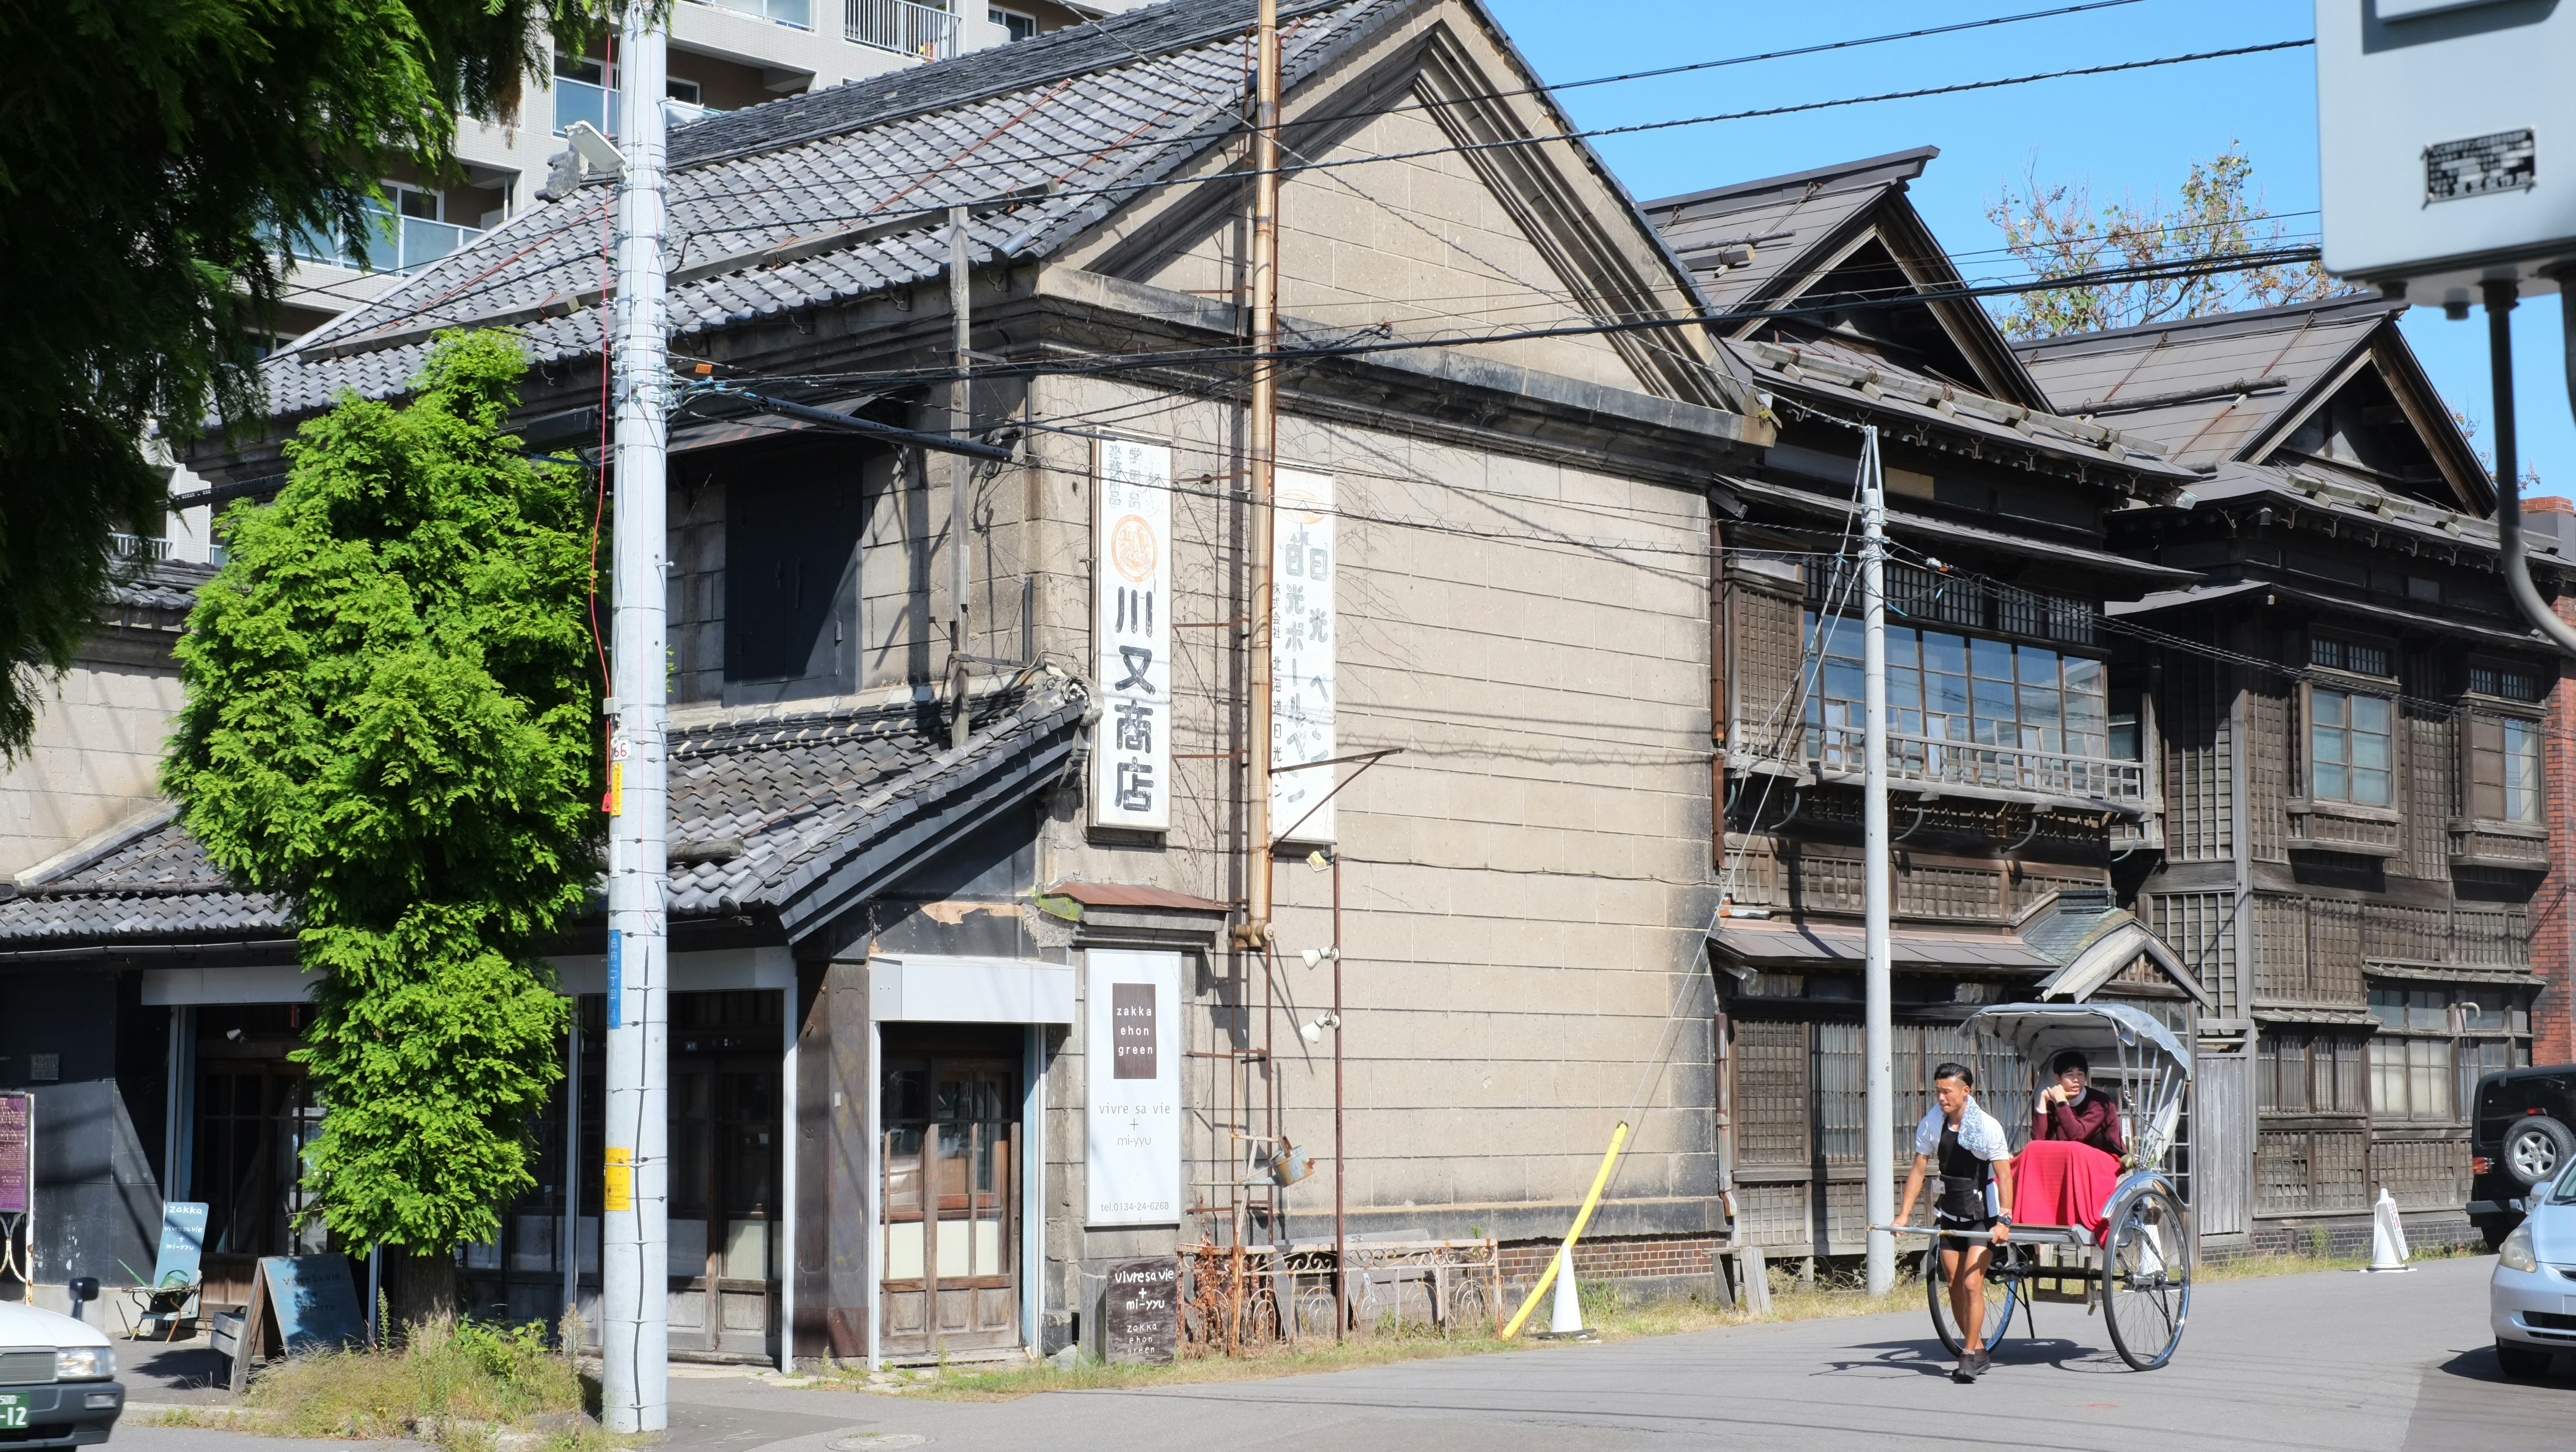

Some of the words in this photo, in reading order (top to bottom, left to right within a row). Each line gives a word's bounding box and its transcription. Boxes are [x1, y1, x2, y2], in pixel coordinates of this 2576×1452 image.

[1114, 586, 1156, 812] 川又商店
[1116, 1005, 1152, 1016] zakka
[1120, 1025, 1149, 1036] ehon
[1118, 1046, 1153, 1056] green
[1099, 1102, 1129, 1114] vivre
[1135, 1105, 1147, 1114] sa
[1153, 1102, 1170, 1114] vie
[1117, 1134, 1151, 1148] mi-yyu
[169, 1205, 202, 1215] zakka
[1101, 1202, 1169, 1212] tel.0134-24-6268
[1115, 1270, 1144, 1283] vivre
[1145, 1272, 1156, 1282] sa
[1158, 1268, 1174, 1281] vie
[1126, 1298, 1164, 1310] mi-yyu
[1126, 1324, 1157, 1333] zakka
[1129, 1336, 1152, 1344] ehon
[1127, 1347, 1155, 1357] green
